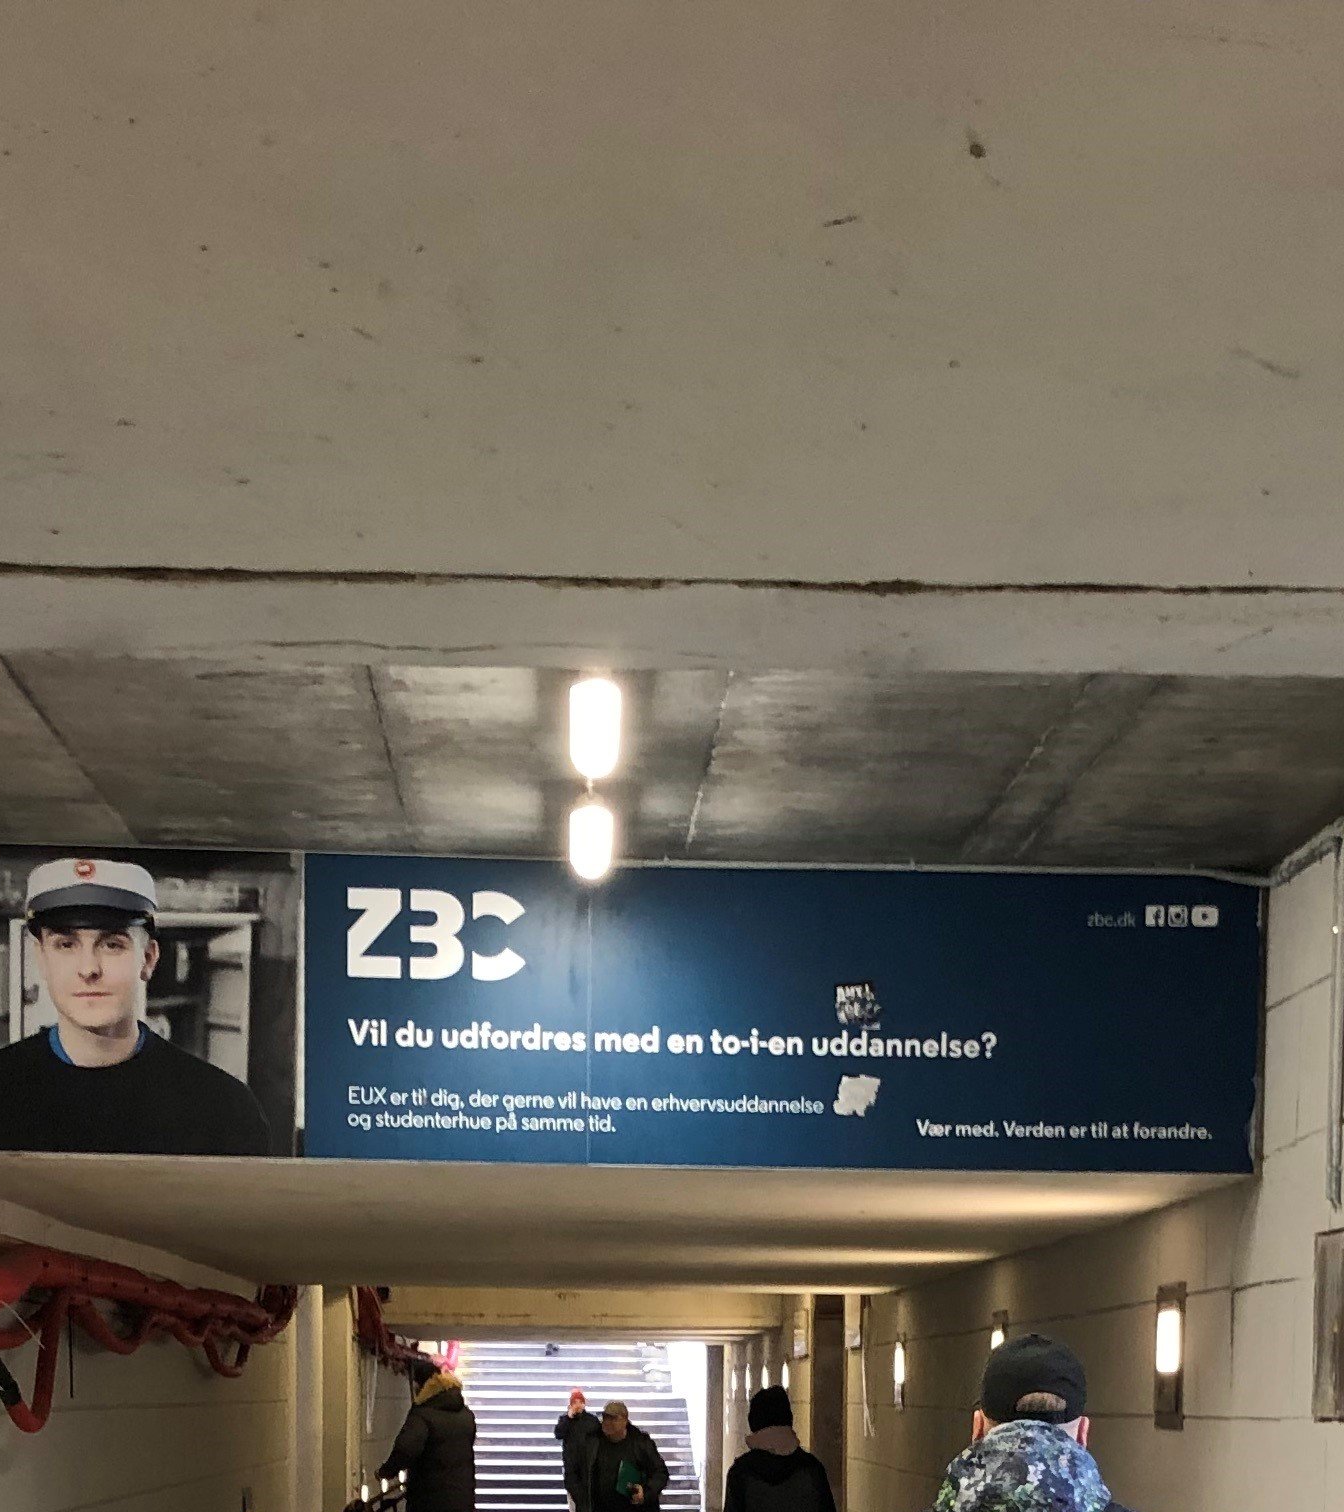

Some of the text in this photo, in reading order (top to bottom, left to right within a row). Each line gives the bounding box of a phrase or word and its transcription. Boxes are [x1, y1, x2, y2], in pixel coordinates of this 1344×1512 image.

[347, 886, 526, 982] ZBC
[348, 1018, 998, 1060] Vil du udfordres med en to-i-en uddannelse?
[348, 1085, 387, 1106] EUX
[390, 1092, 408, 1106] er
[430, 1088, 465, 1111] dig,
[468, 1089, 499, 1109] der
[502, 1094, 556, 1112] gerne
[557, 1091, 578, 1110] vil
[580, 1091, 623, 1111] have
[625, 1096, 649, 1111] en
[651, 1093, 825, 1115] erhvervsuddannelse
[347, 1110, 617, 1133] og studenterhue på samme tid.
[916, 1119, 1213, 1140] Vær med. Verden er til at forandre.
